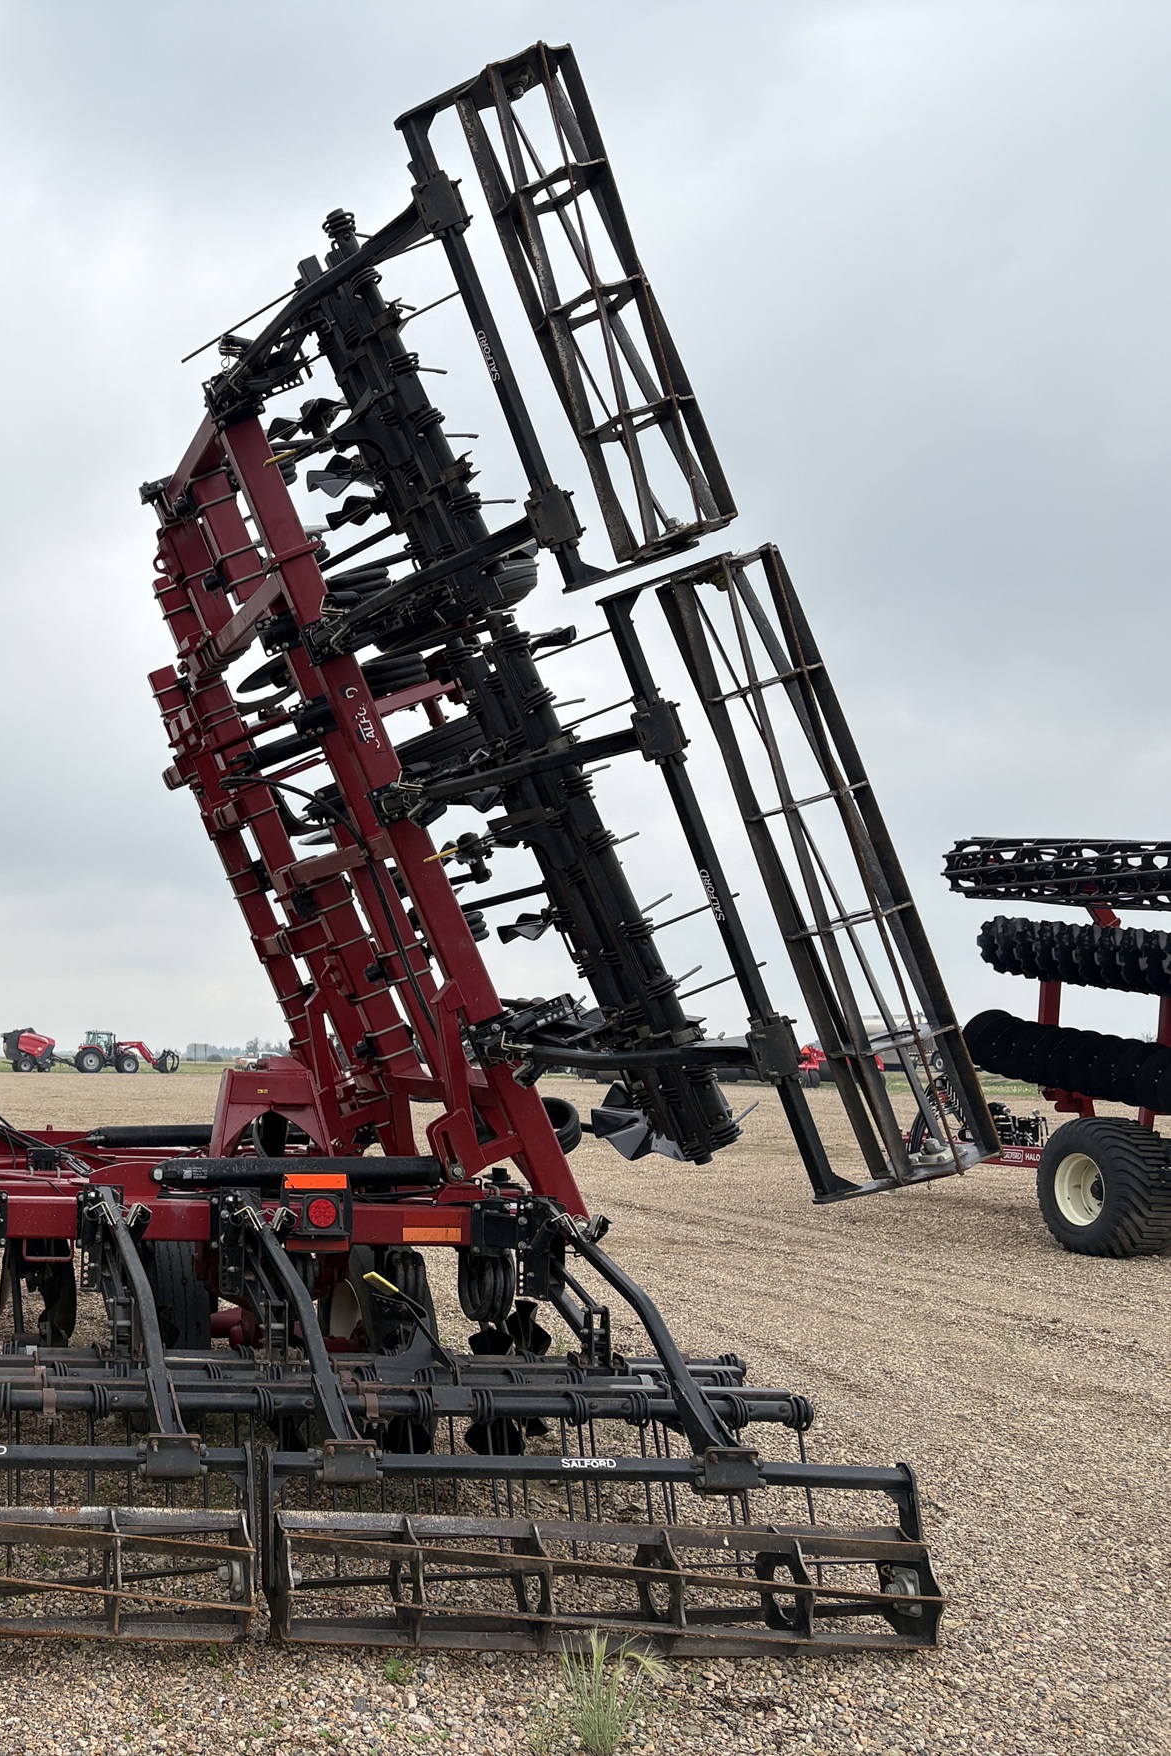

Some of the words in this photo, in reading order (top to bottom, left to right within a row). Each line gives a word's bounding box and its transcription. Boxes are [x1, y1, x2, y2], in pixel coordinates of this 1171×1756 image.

[476, 330, 501, 382] SALFORD
[699, 869, 726, 921] SALFORD
[1025, 1153, 1041, 1161] HALO
[561, 1458, 617, 1469] SALFORD
